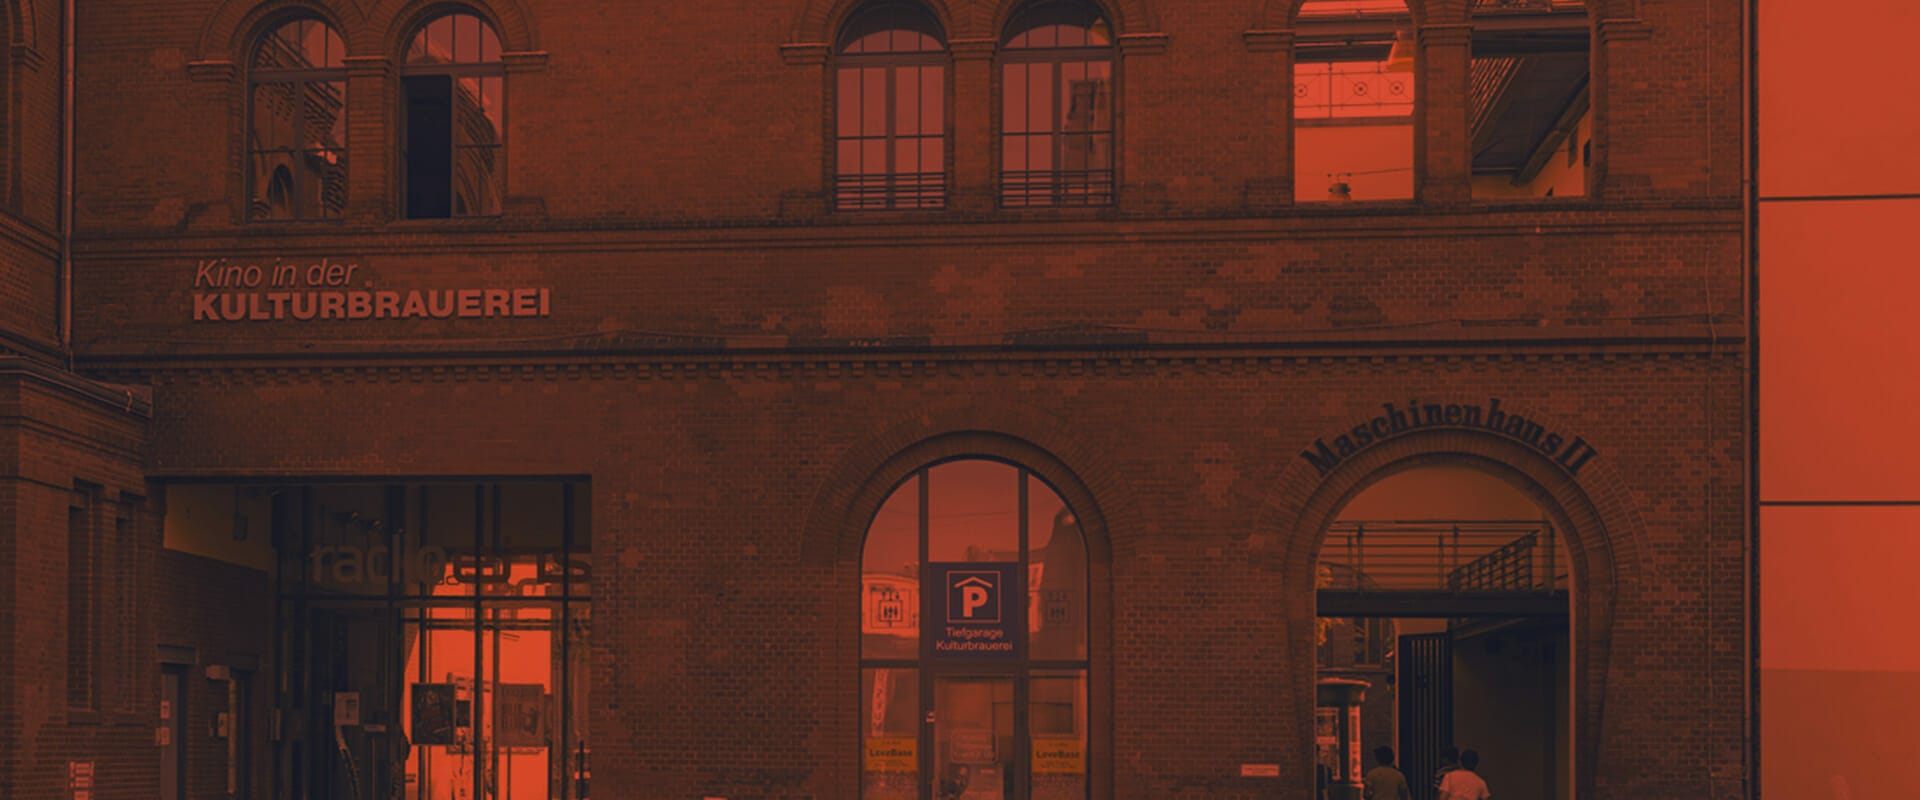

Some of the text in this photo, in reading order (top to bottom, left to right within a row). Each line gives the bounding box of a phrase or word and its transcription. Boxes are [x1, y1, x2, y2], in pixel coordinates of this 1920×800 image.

[194, 258, 358, 287] Kino in der
[193, 289, 550, 321] KULTURBRAUEREI
[1300, 397, 1597, 477] Maschinenhaus II
[963, 586, 988, 617] P
[936, 639, 1013, 651] Kulturbrauerei
[946, 627, 1003, 639] Tiefgarage
